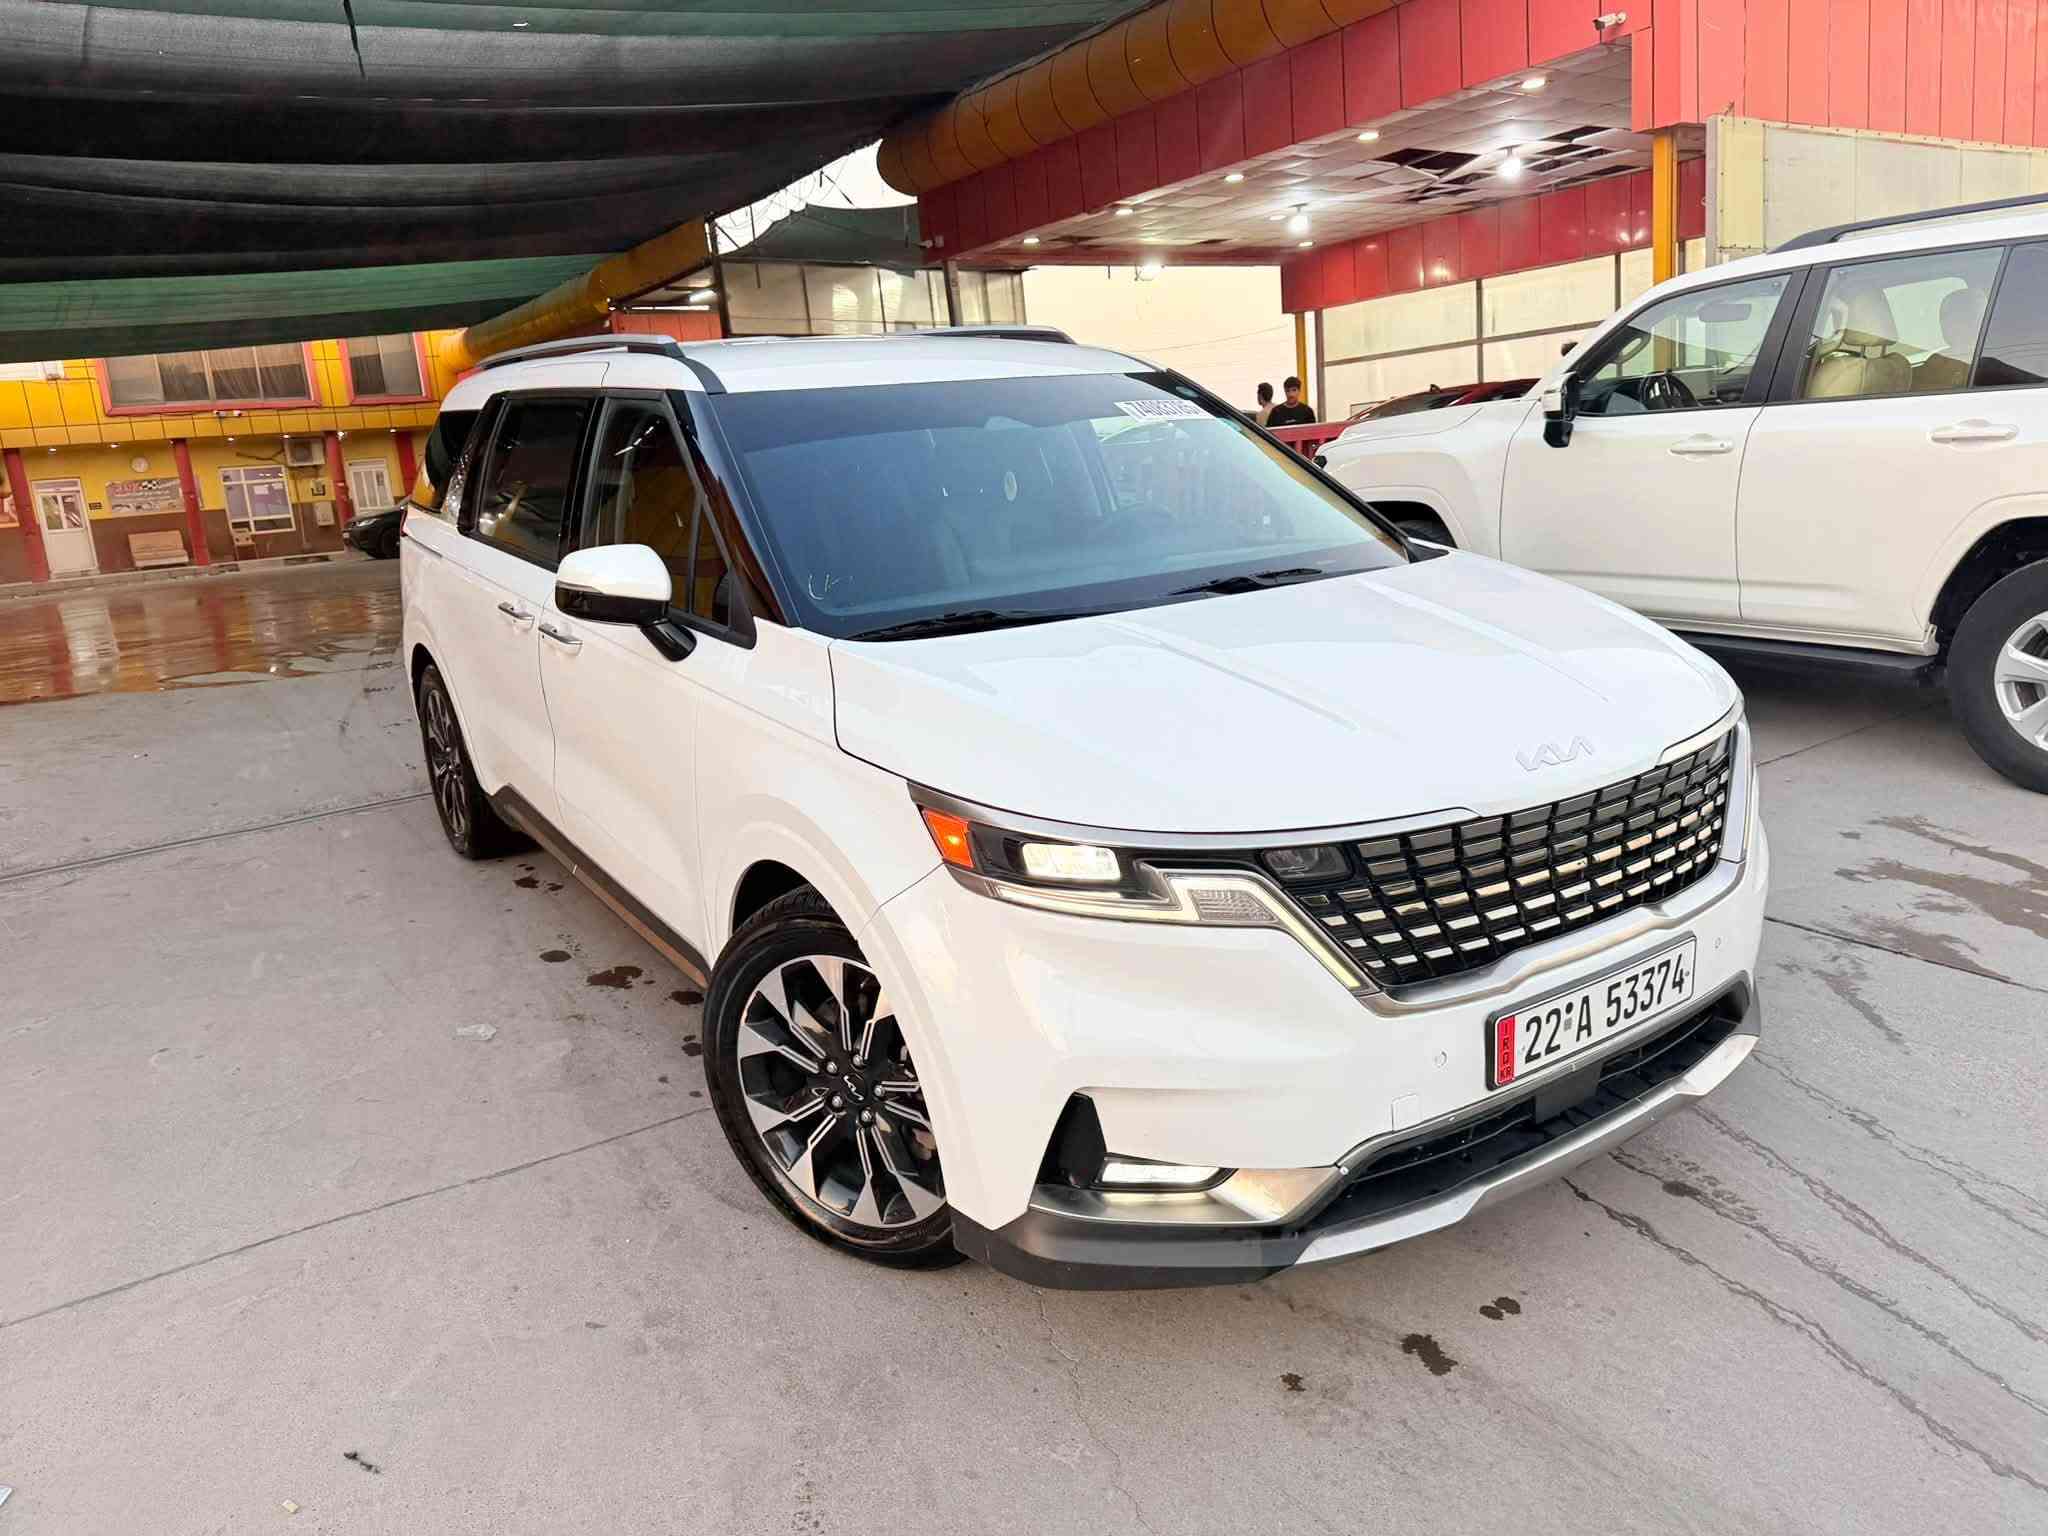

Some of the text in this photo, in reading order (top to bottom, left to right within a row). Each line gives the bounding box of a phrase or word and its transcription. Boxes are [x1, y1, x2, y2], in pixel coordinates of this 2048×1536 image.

[1514, 736, 1595, 772] KIA
[1524, 953, 1684, 1064] 22 A 53374
